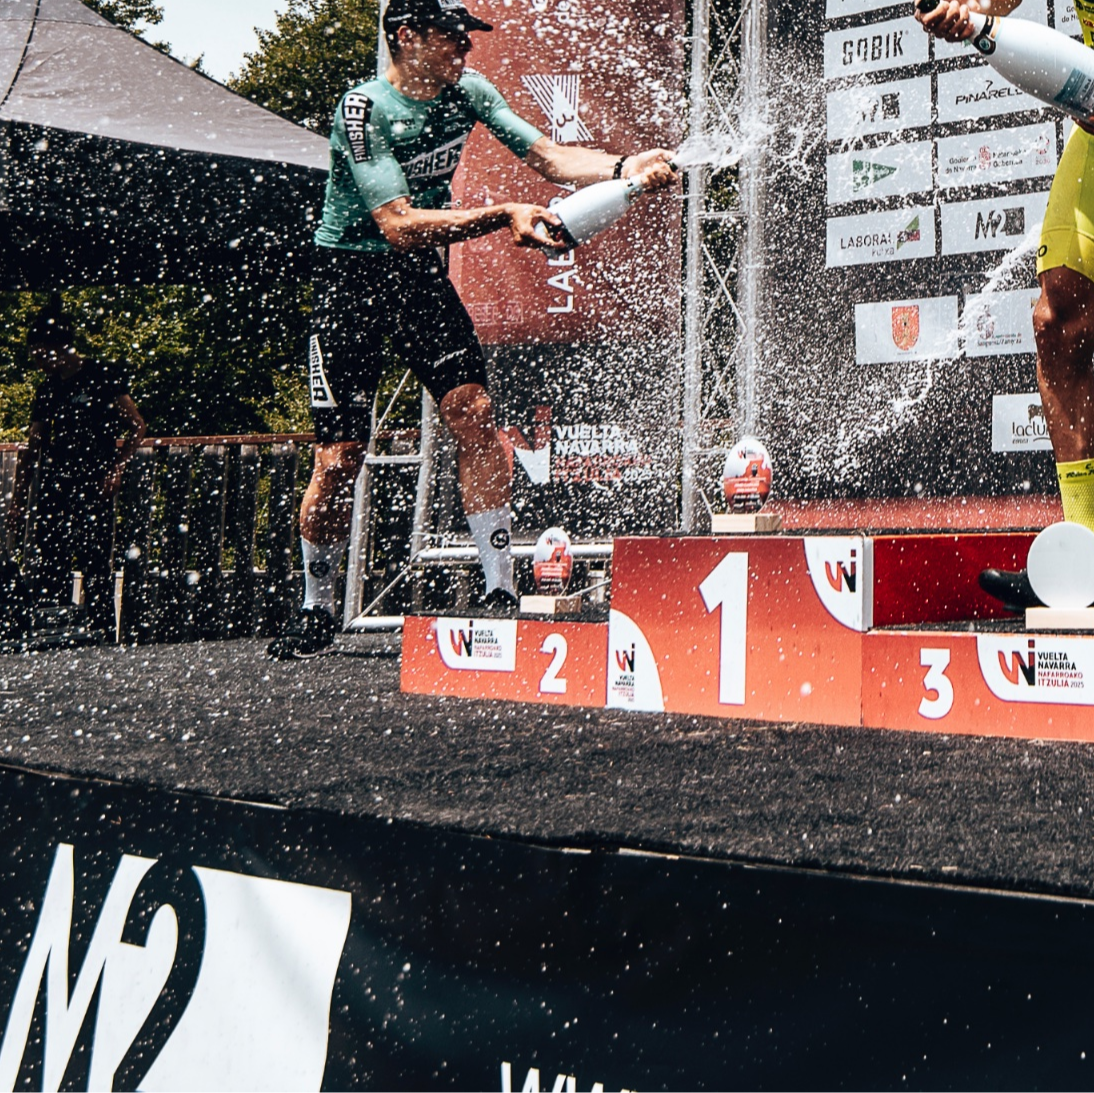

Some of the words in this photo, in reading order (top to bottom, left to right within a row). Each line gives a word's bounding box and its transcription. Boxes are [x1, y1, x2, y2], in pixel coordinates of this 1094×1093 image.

[955, 80, 1023, 105] PINARELL
[346, 95, 367, 163] FINISHER
[1012, 422, 1049, 436] lactu
[699, 552, 749, 704] 1
[540, 633, 567, 693] 2
[1038, 652, 1068, 661] VUELTA
[1038, 661, 1076, 671] NAVARRA
[918, 648, 953, 720] 3
[1038, 679, 1069, 687] ITZULIA
